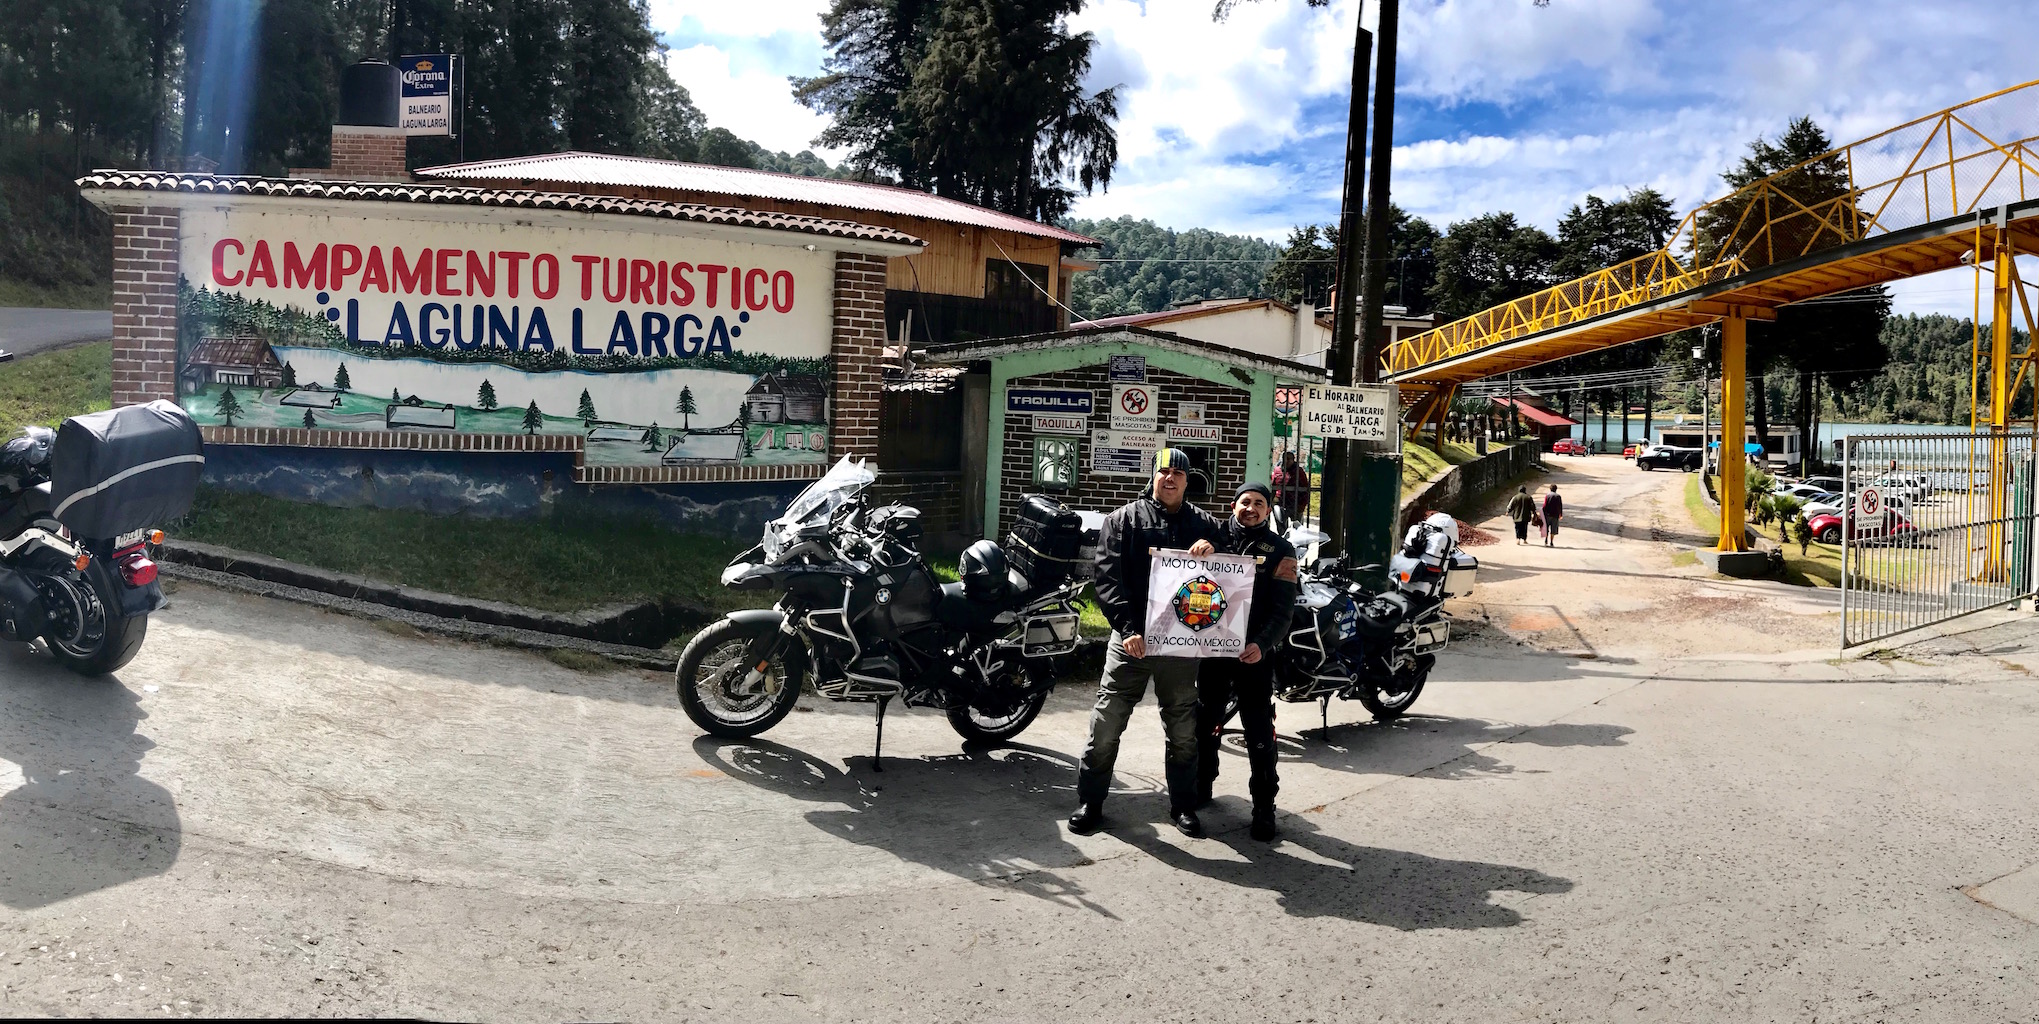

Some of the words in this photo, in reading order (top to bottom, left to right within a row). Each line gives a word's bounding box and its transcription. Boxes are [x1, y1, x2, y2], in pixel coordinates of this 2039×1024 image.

[402, 70, 446, 85] Corona
[414, 81, 434, 89] Extra
[408, 105, 442, 114] BALNEARIO
[402, 119, 426, 128] LAGUNA
[427, 119, 447, 128] LARGA
[212, 238, 560, 300] CAMPAMENTO
[572, 254, 795, 313] TURISTICO
[346, 298, 554, 352] LAGUNA
[572, 307, 733, 359] LARGA
[1011, 396, 1090, 407] TAQUILLA
[1309, 388, 1322, 400] EL
[1325, 389, 1364, 403] HORARIO
[1346, 404, 1385, 416] BALNEARIO
[1037, 419, 1082, 429] TAQUILLA
[1308, 411, 1344, 424] LAGUNA
[1349, 415, 1380, 427] LARGA
[1171, 427, 1217, 438] TAQUILLA
[1320, 424, 1332, 433] ES
[1336, 425, 1347, 435] DE
[1161, 557, 1197, 570] MOTO
[1200, 560, 1245, 575] TURISTA
[1147, 635, 1160, 646] EN
[1162, 635, 1201, 647] ACCIÓN
[1203, 635, 1241, 648] MÉXICO
